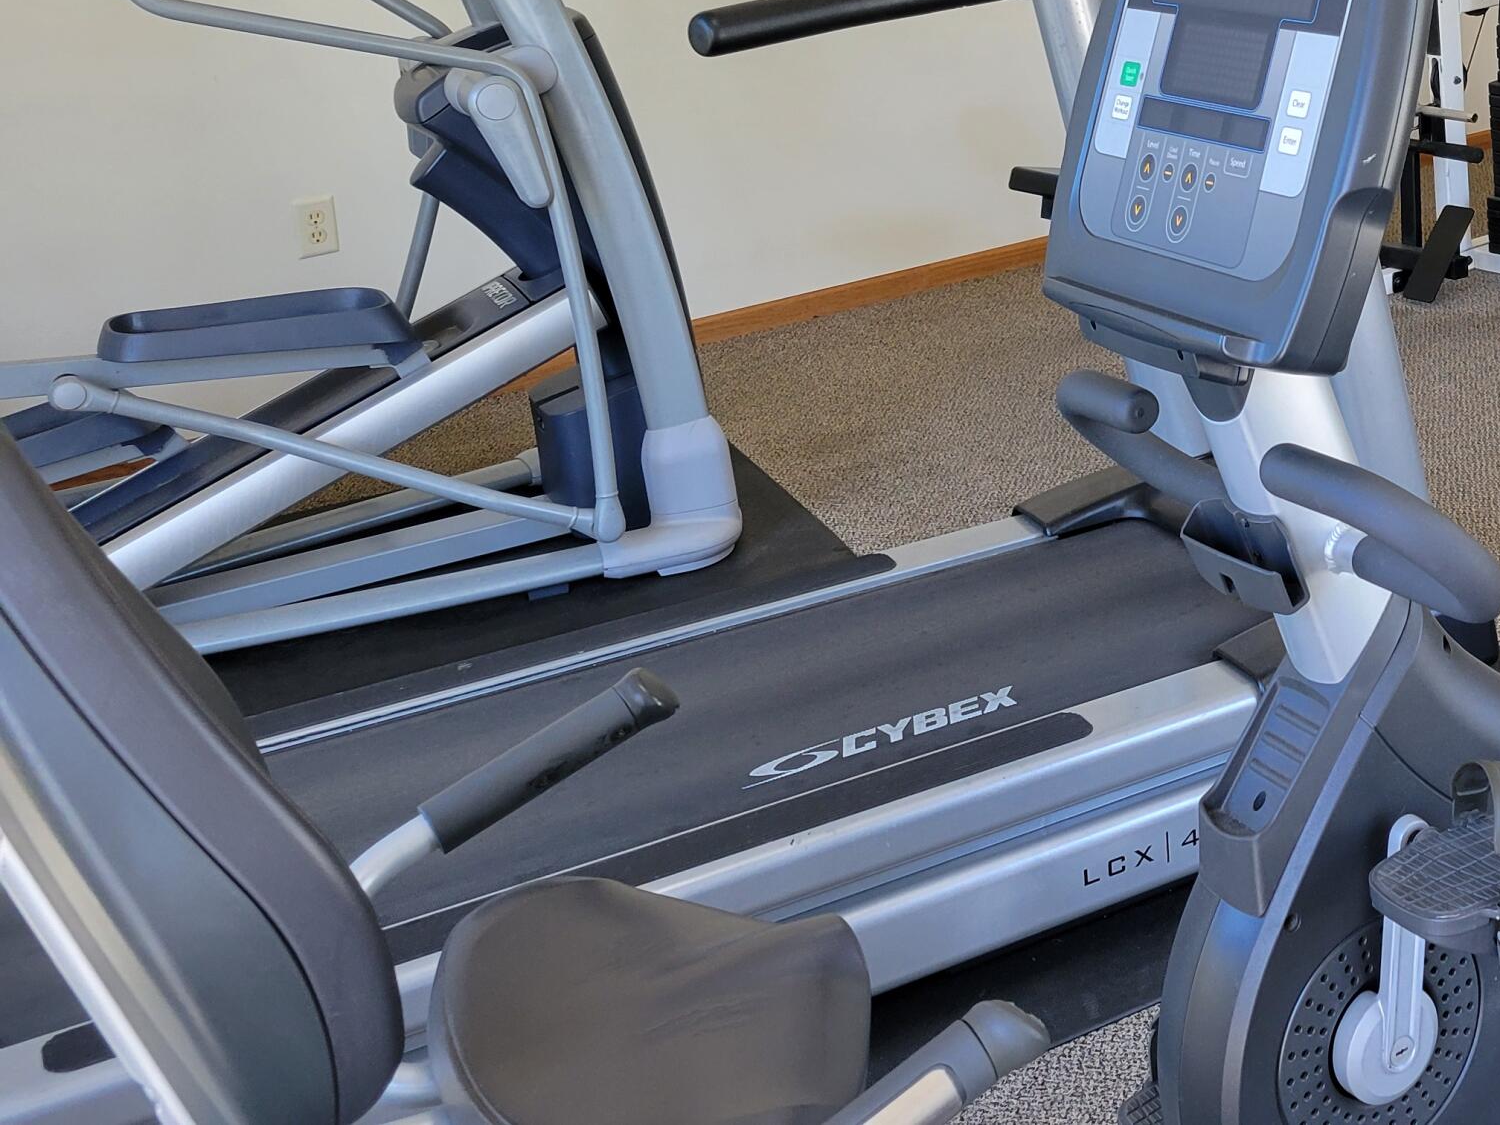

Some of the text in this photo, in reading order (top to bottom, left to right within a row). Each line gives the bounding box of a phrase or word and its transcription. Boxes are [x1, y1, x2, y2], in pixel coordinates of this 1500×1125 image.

[1292, 98, 1305, 108] Clear
[1146, 140, 1160, 150] Level
[1282, 135, 1297, 146] Enter
[1189, 148, 1201, 158] Time
[1230, 156, 1246, 169] Speed
[841, 685, 1018, 759] CYBEX
